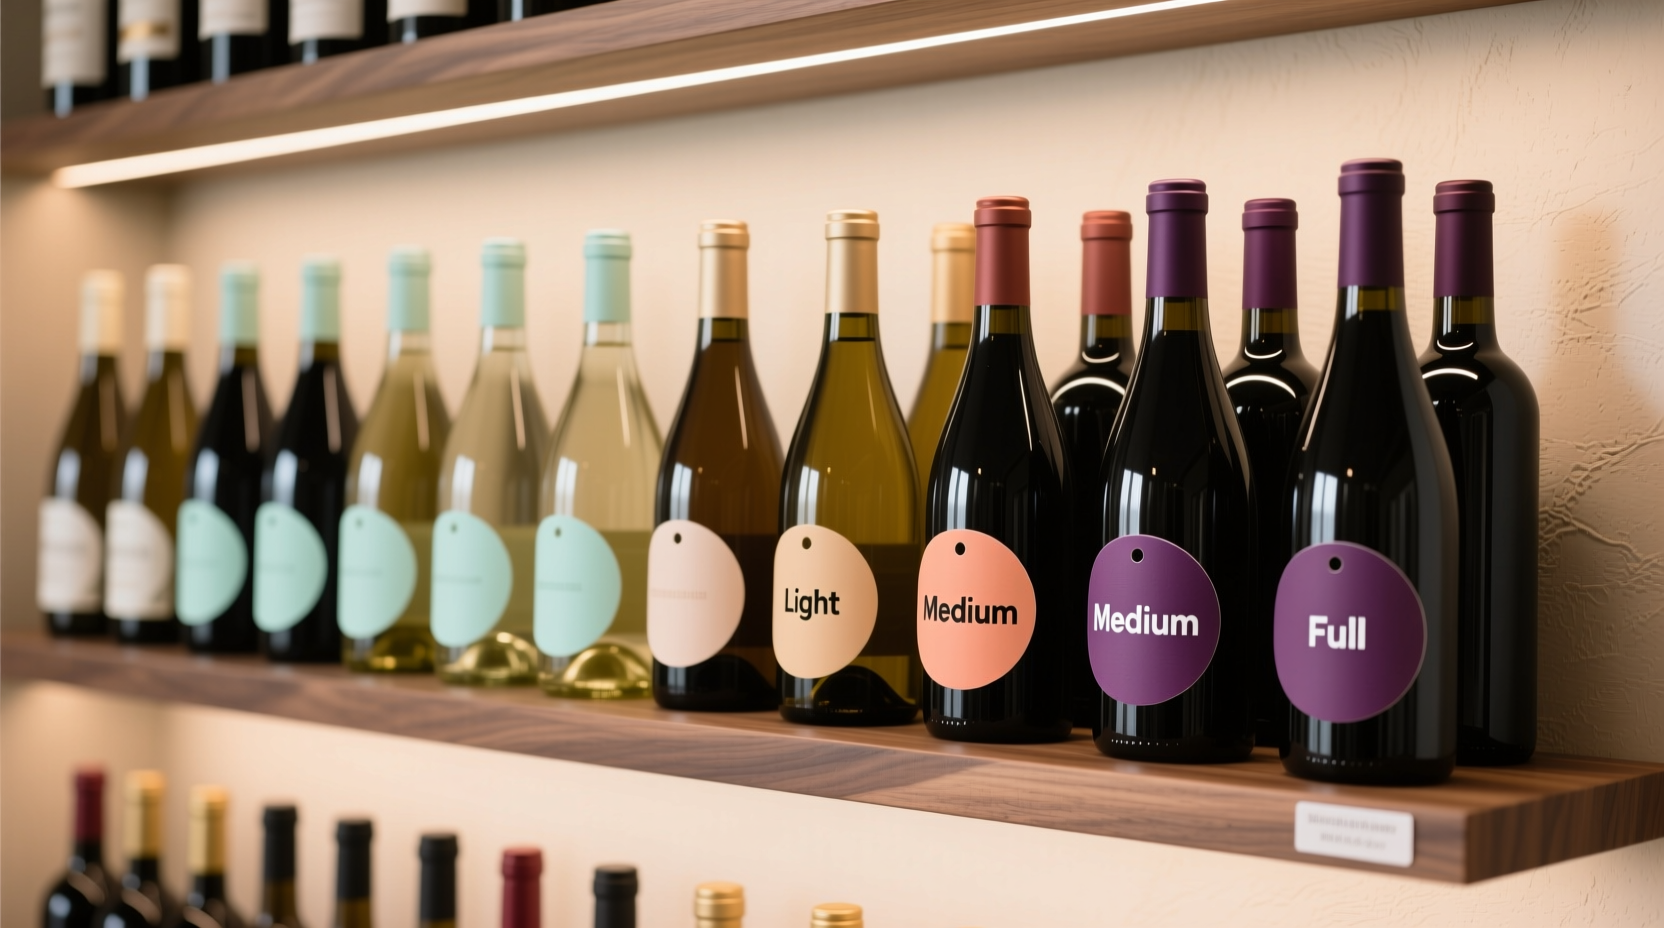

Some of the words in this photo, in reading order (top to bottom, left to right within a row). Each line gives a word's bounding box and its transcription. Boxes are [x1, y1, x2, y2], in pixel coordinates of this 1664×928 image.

[784, 588, 840, 621] Light
[923, 595, 1018, 625] Medium
[1093, 603, 1199, 636] Medium
[1308, 615, 1366, 650] Full
